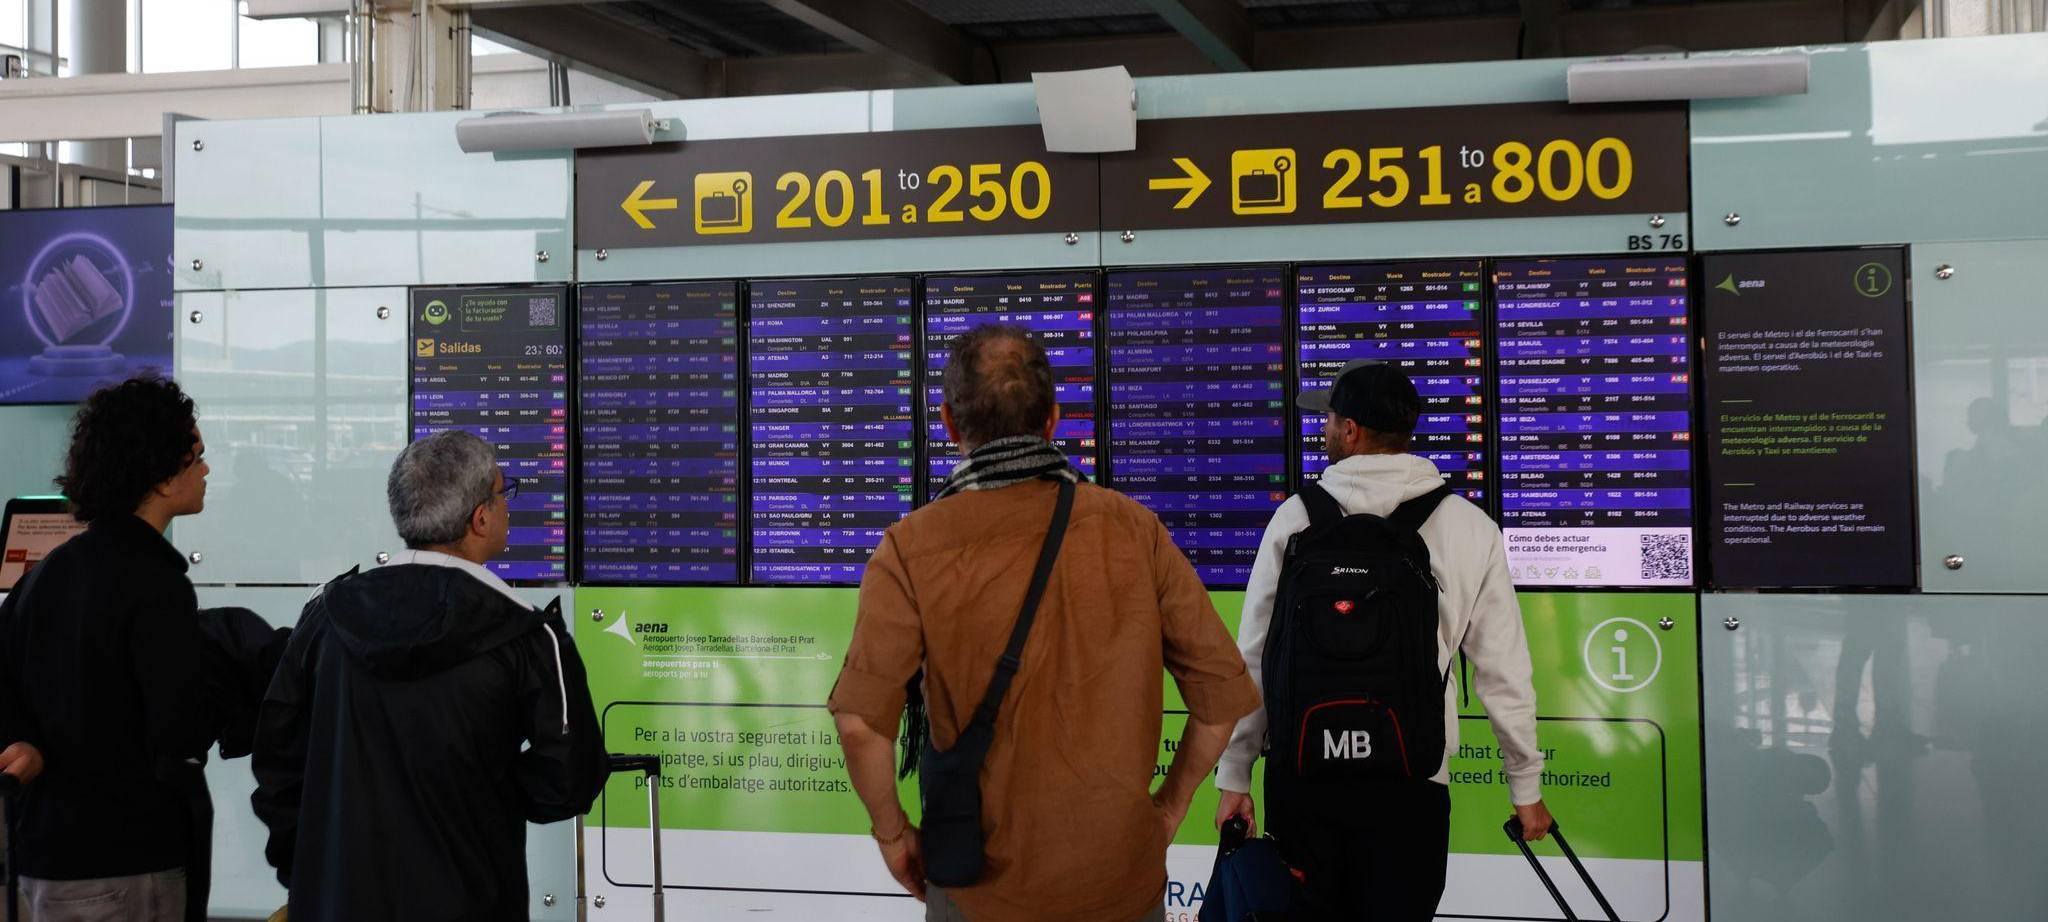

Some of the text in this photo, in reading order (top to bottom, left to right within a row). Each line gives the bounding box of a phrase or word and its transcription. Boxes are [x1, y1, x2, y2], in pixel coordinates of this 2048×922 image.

[1322, 137, 1633, 209] 251 to a 800
[776, 161, 1051, 229] 201 to a 250
[1628, 235, 1683, 251] BS 76
[1739, 279, 1765, 288] aena
[440, 342, 482, 353] Salidas
[1729, 414, 1762, 422] servicio
[1832, 412, 1874, 420] Ferrocarril
[1766, 502, 1782, 510] and
[1784, 502, 1814, 512] Railway
[1724, 514, 1769, 522] interrupted
[1509, 534, 1532, 542] Cómo
[1534, 534, 1560, 542] debes
[1724, 536, 1772, 544] operational.
[1556, 546, 1607, 554] emergencia
[1331, 566, 1368, 574] SRIXON
[635, 623, 668, 633] aena
[643, 635, 684, 644] Aeropuerto
[708, 635, 748, 643] Tarradellas
[750, 636, 797, 644] Barcelona-El
[799, 636, 814, 644] Prat
[643, 644, 674, 652] Aeroport
[696, 644, 734, 652] Tarradellas
[643, 661, 691, 669] aeropuertos
[635, 728, 658, 742] Per
[662, 732, 669, 741] a
[674, 728, 686, 742] la
[690, 730, 734, 742] vostra
[738, 732, 807, 747] seguretat
[812, 730, 815, 744] i
[820, 731, 831, 744] la
[1324, 730, 1371, 759] MB
[1459, 744, 1492, 758] that
[660, 750, 708, 768] ipatge,
[712, 753, 724, 766] si
[728, 756, 744, 766] us
[749, 754, 782, 768] plau,
[636, 774, 850, 793] pts d'embalatge autoritzats.
[1542, 771, 1611, 787] thorized
